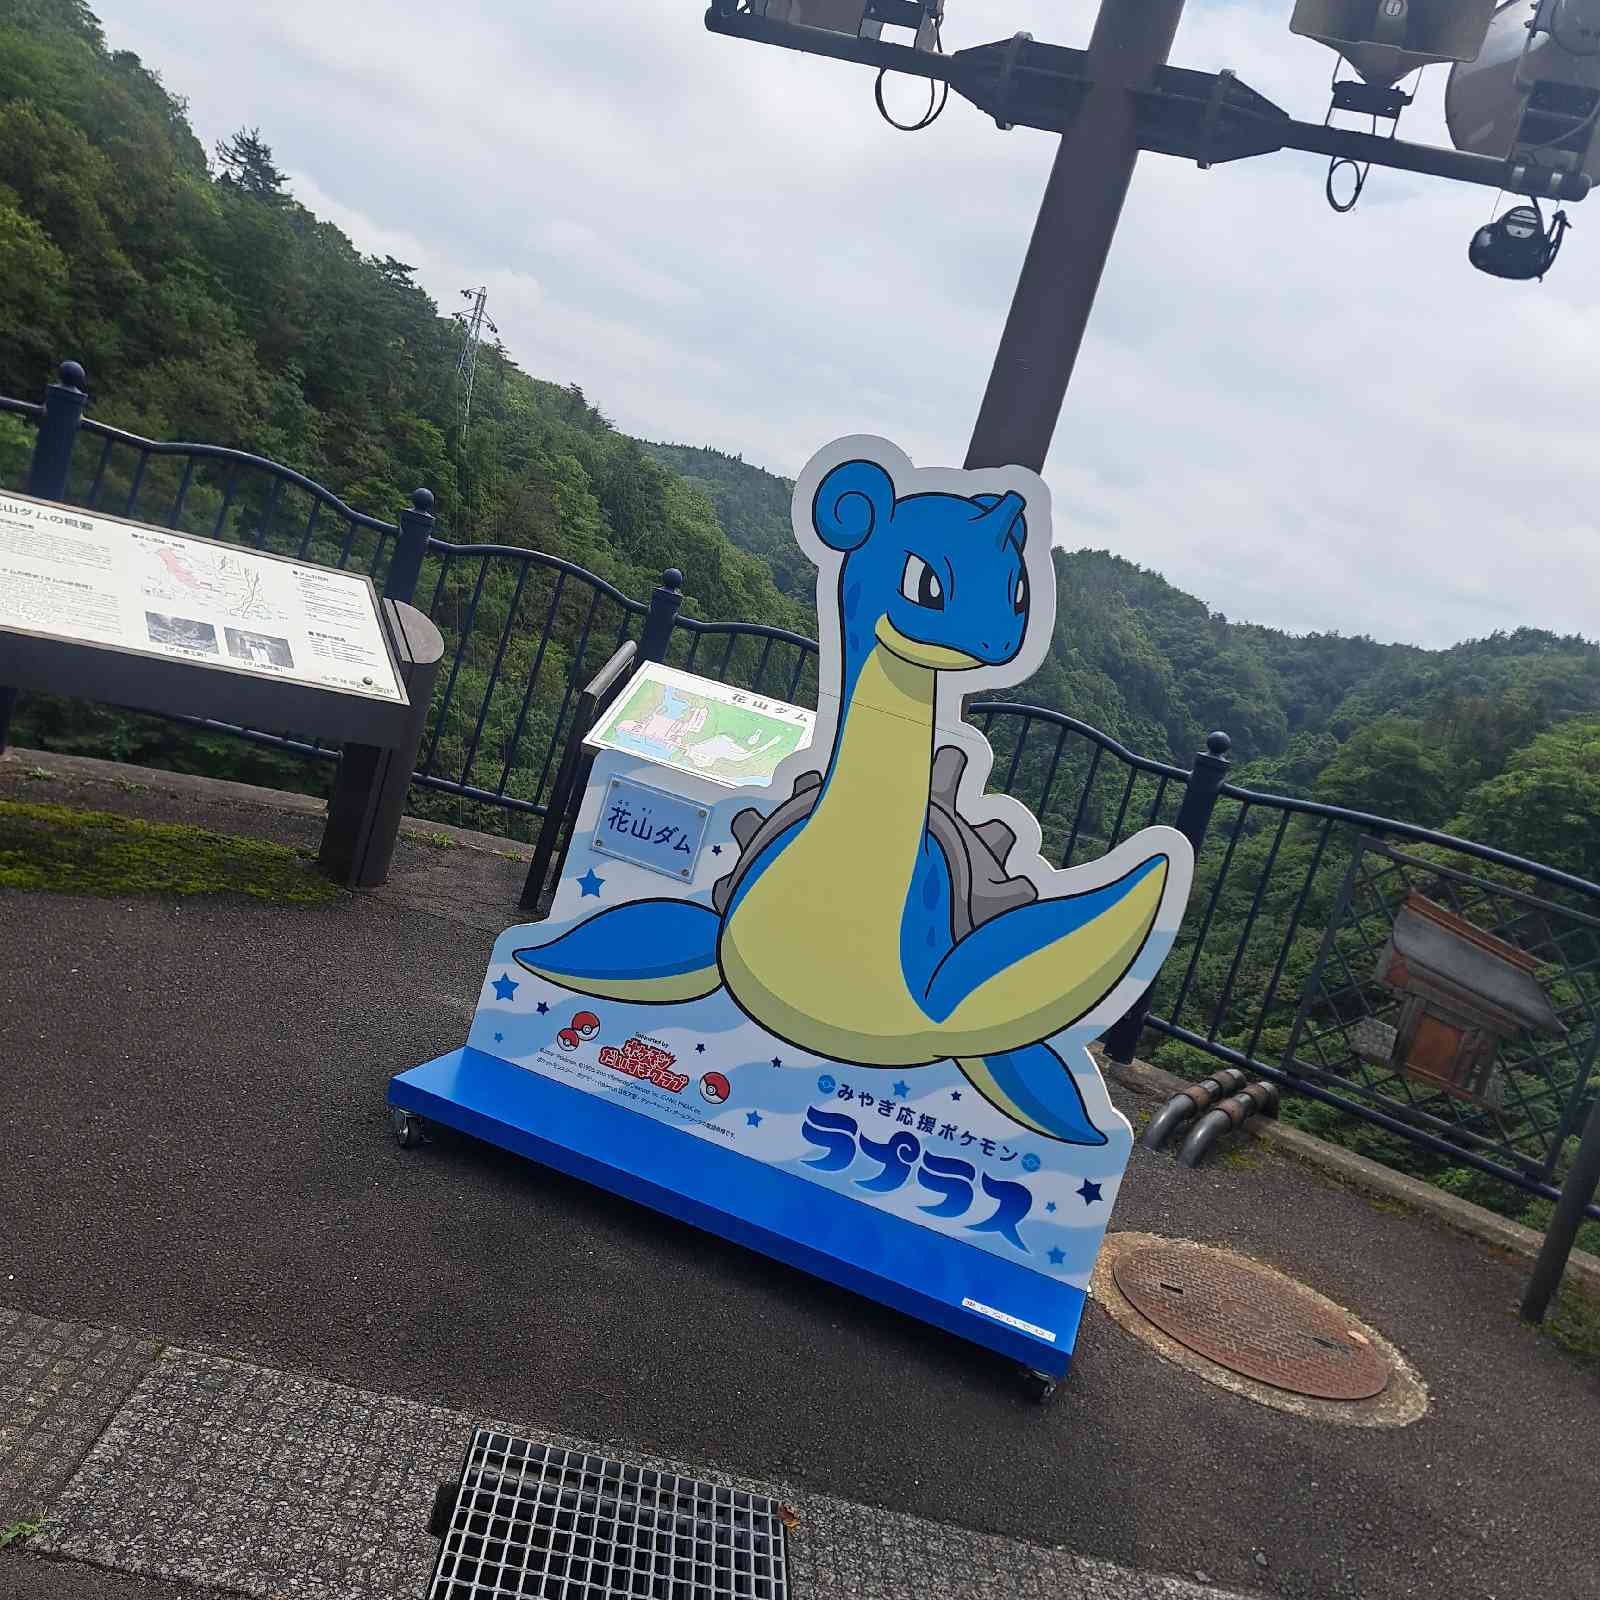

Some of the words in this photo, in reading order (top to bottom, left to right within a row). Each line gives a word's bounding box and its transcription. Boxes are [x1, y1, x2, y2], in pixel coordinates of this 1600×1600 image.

[731, 692, 808, 722] 花山ダム
[607, 806, 691, 854] 花山ダム
[836, 1083, 1019, 1163] みやぎ応援ポケモン
[799, 1104, 1033, 1255] ラプラス
